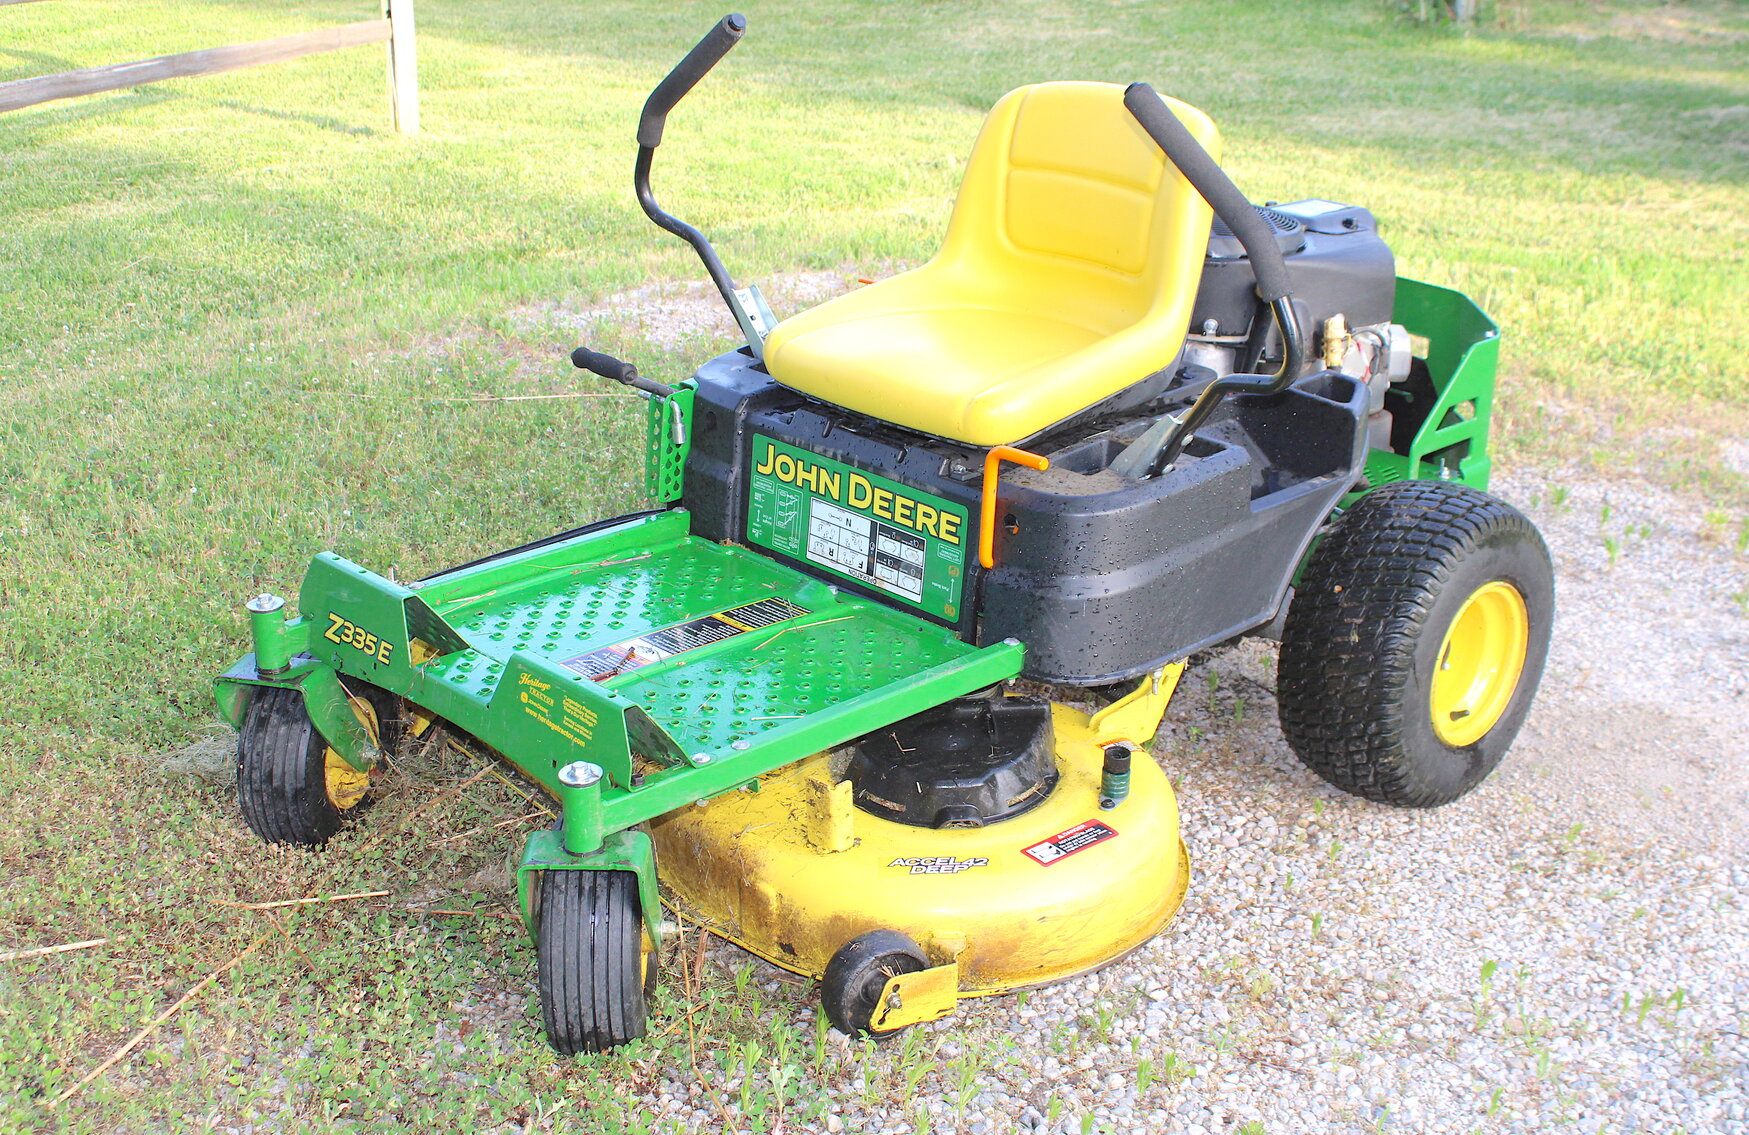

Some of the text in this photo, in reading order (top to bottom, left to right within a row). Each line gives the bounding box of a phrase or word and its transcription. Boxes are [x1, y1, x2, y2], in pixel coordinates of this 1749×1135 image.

[757, 443, 961, 545] JOHN DEERE
[846, 519, 852, 527] N
[828, 548, 834, 556] R
[858, 561, 864, 569] F
[848, 569, 877, 585] OPERATION
[518, 673, 551, 691] Heritage
[529, 686, 555, 706] TRACTOR
[1061, 824, 1087, 837] DANGER
[909, 864, 970, 875] DEEP
